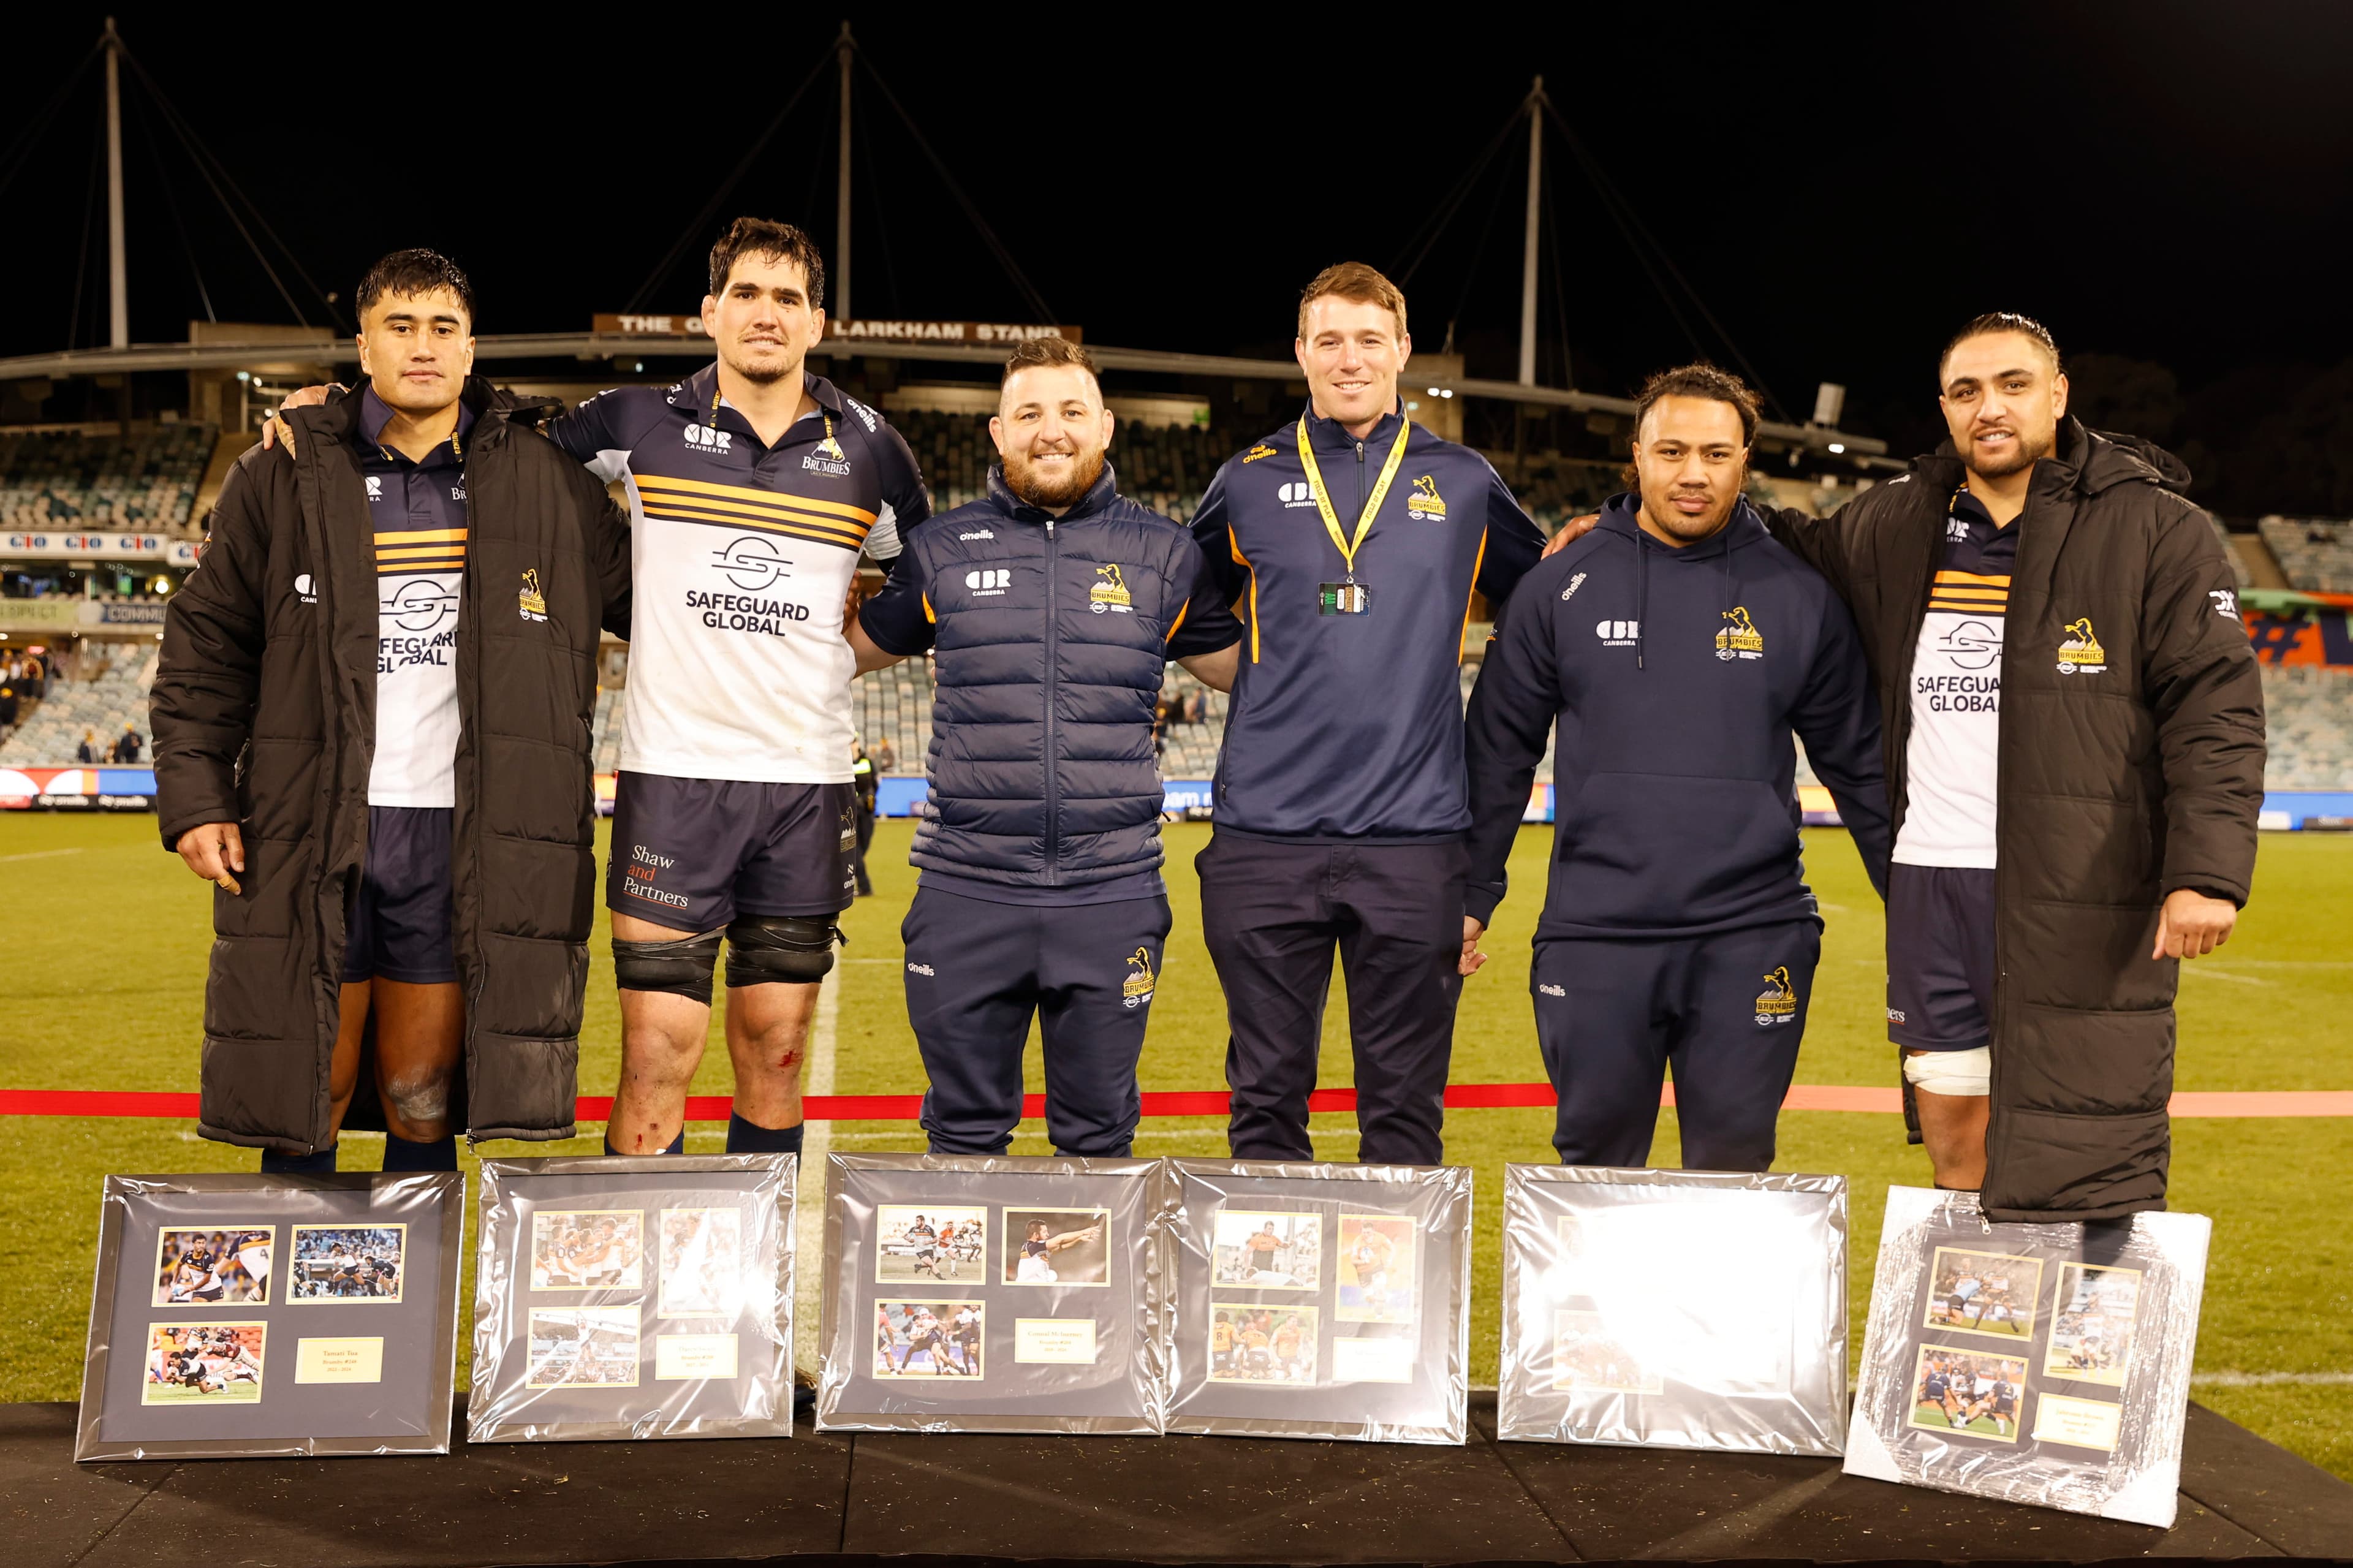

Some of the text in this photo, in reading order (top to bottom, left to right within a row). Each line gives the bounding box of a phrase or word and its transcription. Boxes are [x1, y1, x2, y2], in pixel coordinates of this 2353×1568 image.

[617, 316, 673, 333] THE
[832, 320, 1061, 341] LARKHAM STAND
[684, 423, 732, 449] CBR
[685, 443, 729, 455] CANBERRA
[801, 455, 851, 475] BRUMBIES
[1278, 482, 1316, 502] CB
[1366, 501, 1376, 519] FIELD
[1377, 480, 1387, 494] PLAY
[1324, 504, 1333, 519] PLAY
[965, 569, 1011, 589] CBR
[686, 589, 809, 621] SAFEGUARD
[1091, 591, 1130, 603] BRUMBIES
[109, 606, 167, 621] COMMU
[703, 612, 786, 637] GLOBAL
[1718, 638, 1762, 648] BRUMBIES
[2060, 651, 2103, 660] BRUMBIES
[1917, 676, 2000, 694] SAFEGUA
[1930, 694, 1999, 713] GLOBA
[632, 844, 675, 869] Shaw
[627, 864, 656, 882] and
[624, 876, 688, 907] Partners
[1757, 1001, 1796, 1010] BRUMBIES
